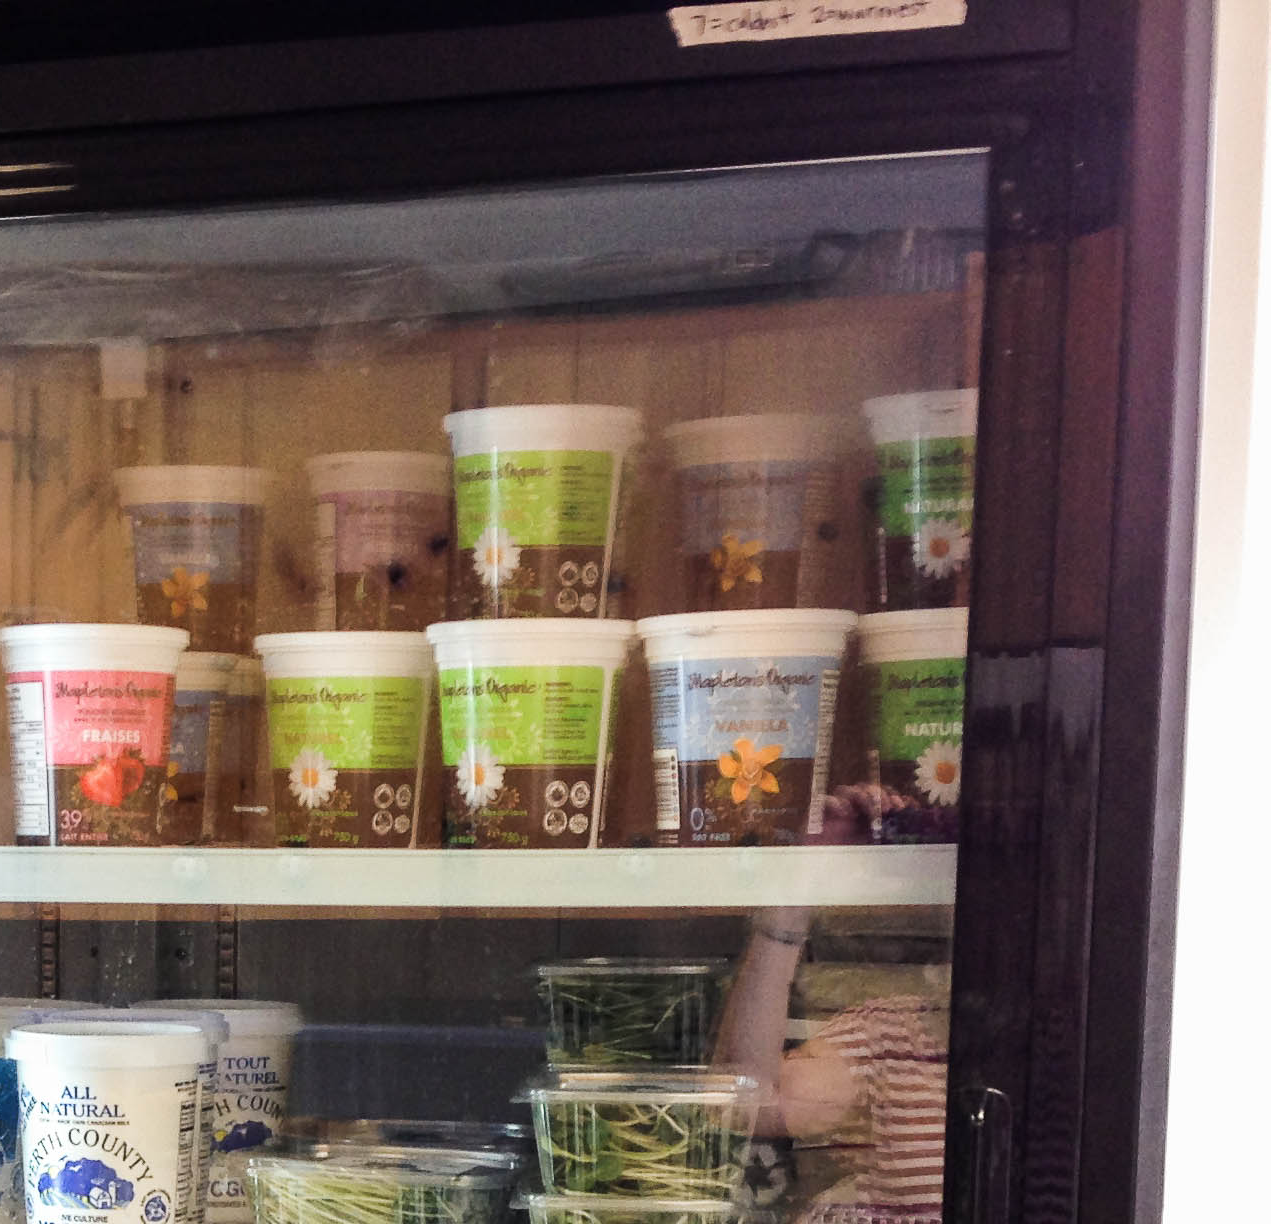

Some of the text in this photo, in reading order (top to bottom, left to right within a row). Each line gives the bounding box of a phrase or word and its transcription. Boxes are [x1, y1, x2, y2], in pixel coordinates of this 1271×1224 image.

[82, 729, 141, 743] FRAISES
[224, 1056, 271, 1071] TOUT
[61, 1085, 97, 1100] ALL
[40, 1101, 126, 1119] NATURAL
[68, 1128, 154, 1182] COUNTY
[73, 1215, 109, 1224] CULTURE
